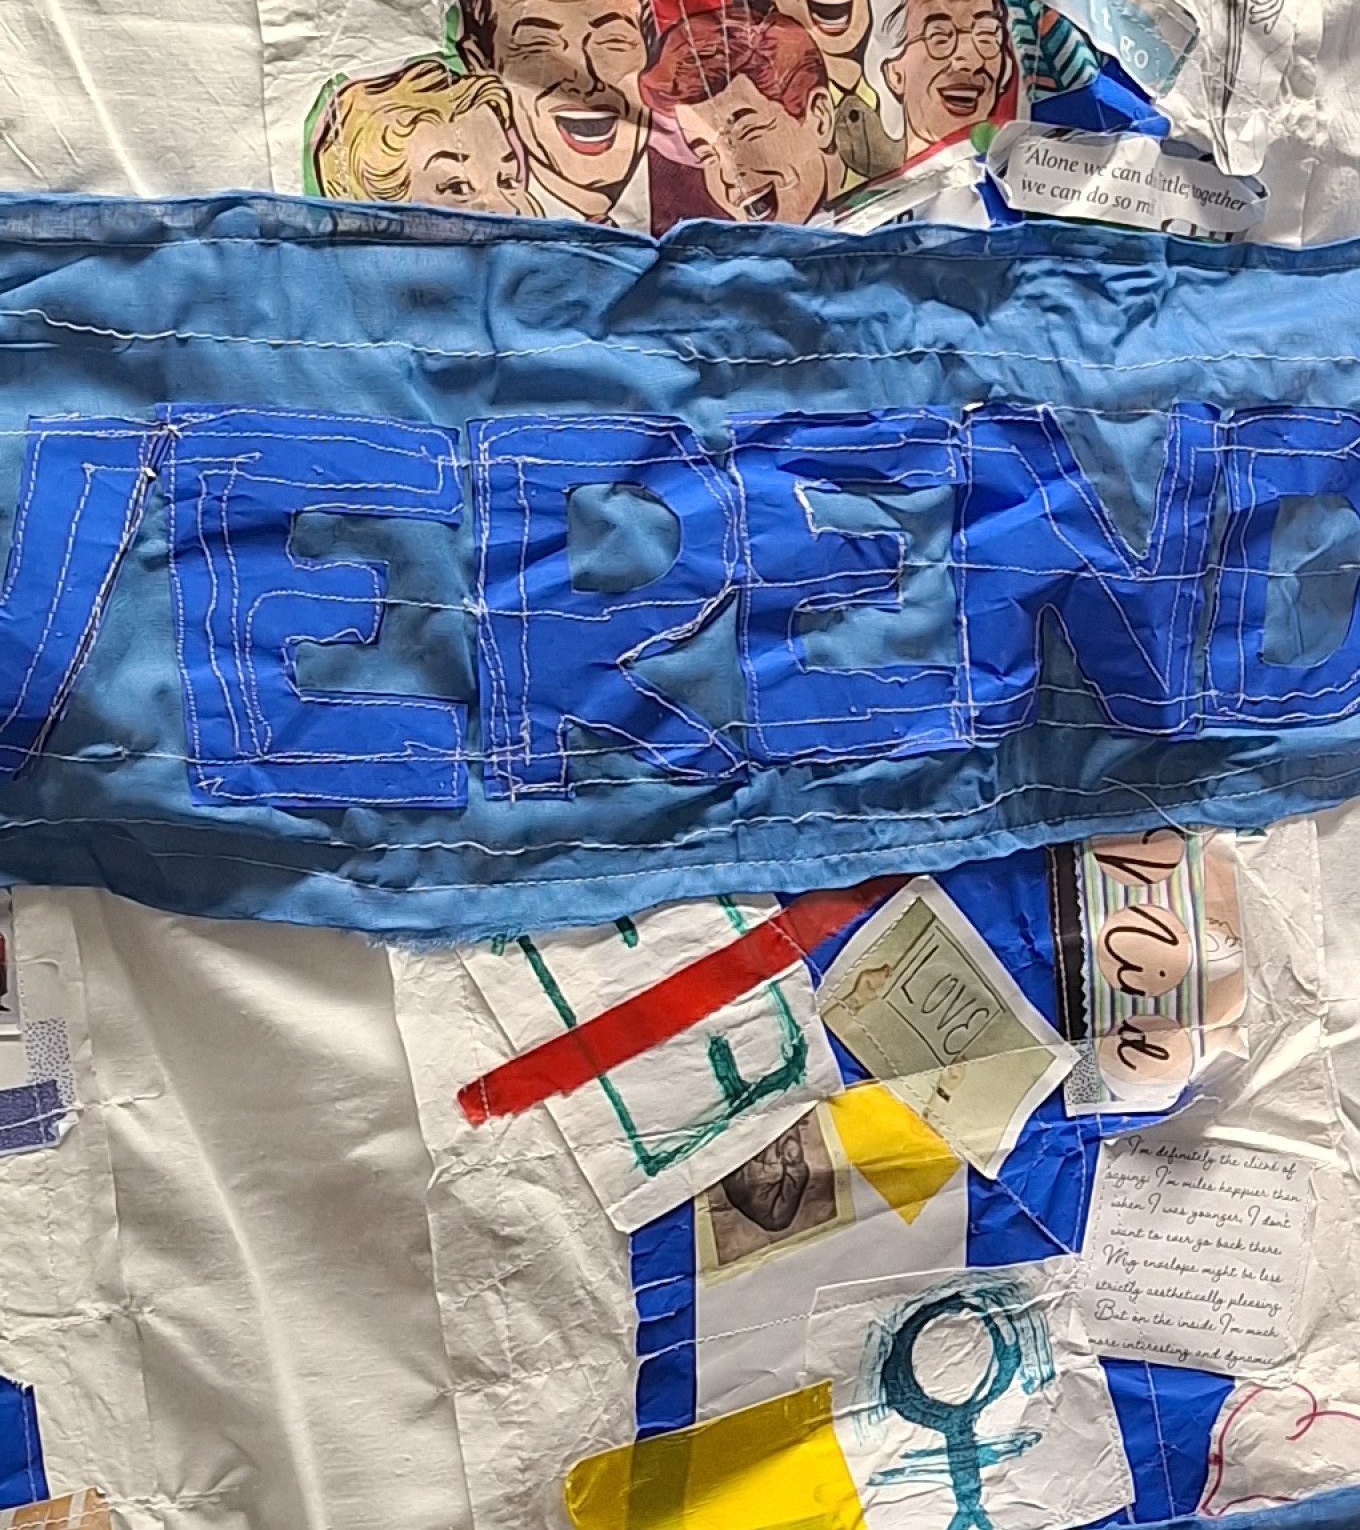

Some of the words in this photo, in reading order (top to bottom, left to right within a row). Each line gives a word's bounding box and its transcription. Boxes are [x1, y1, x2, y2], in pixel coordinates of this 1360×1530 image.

[1111, 167, 1141, 183] can
[1022, 178, 1046, 195] we
[1050, 185, 1082, 200] can
[1086, 185, 1109, 204] do
[1112, 195, 1132, 209] so
[900, 944, 990, 1056] LOVE
